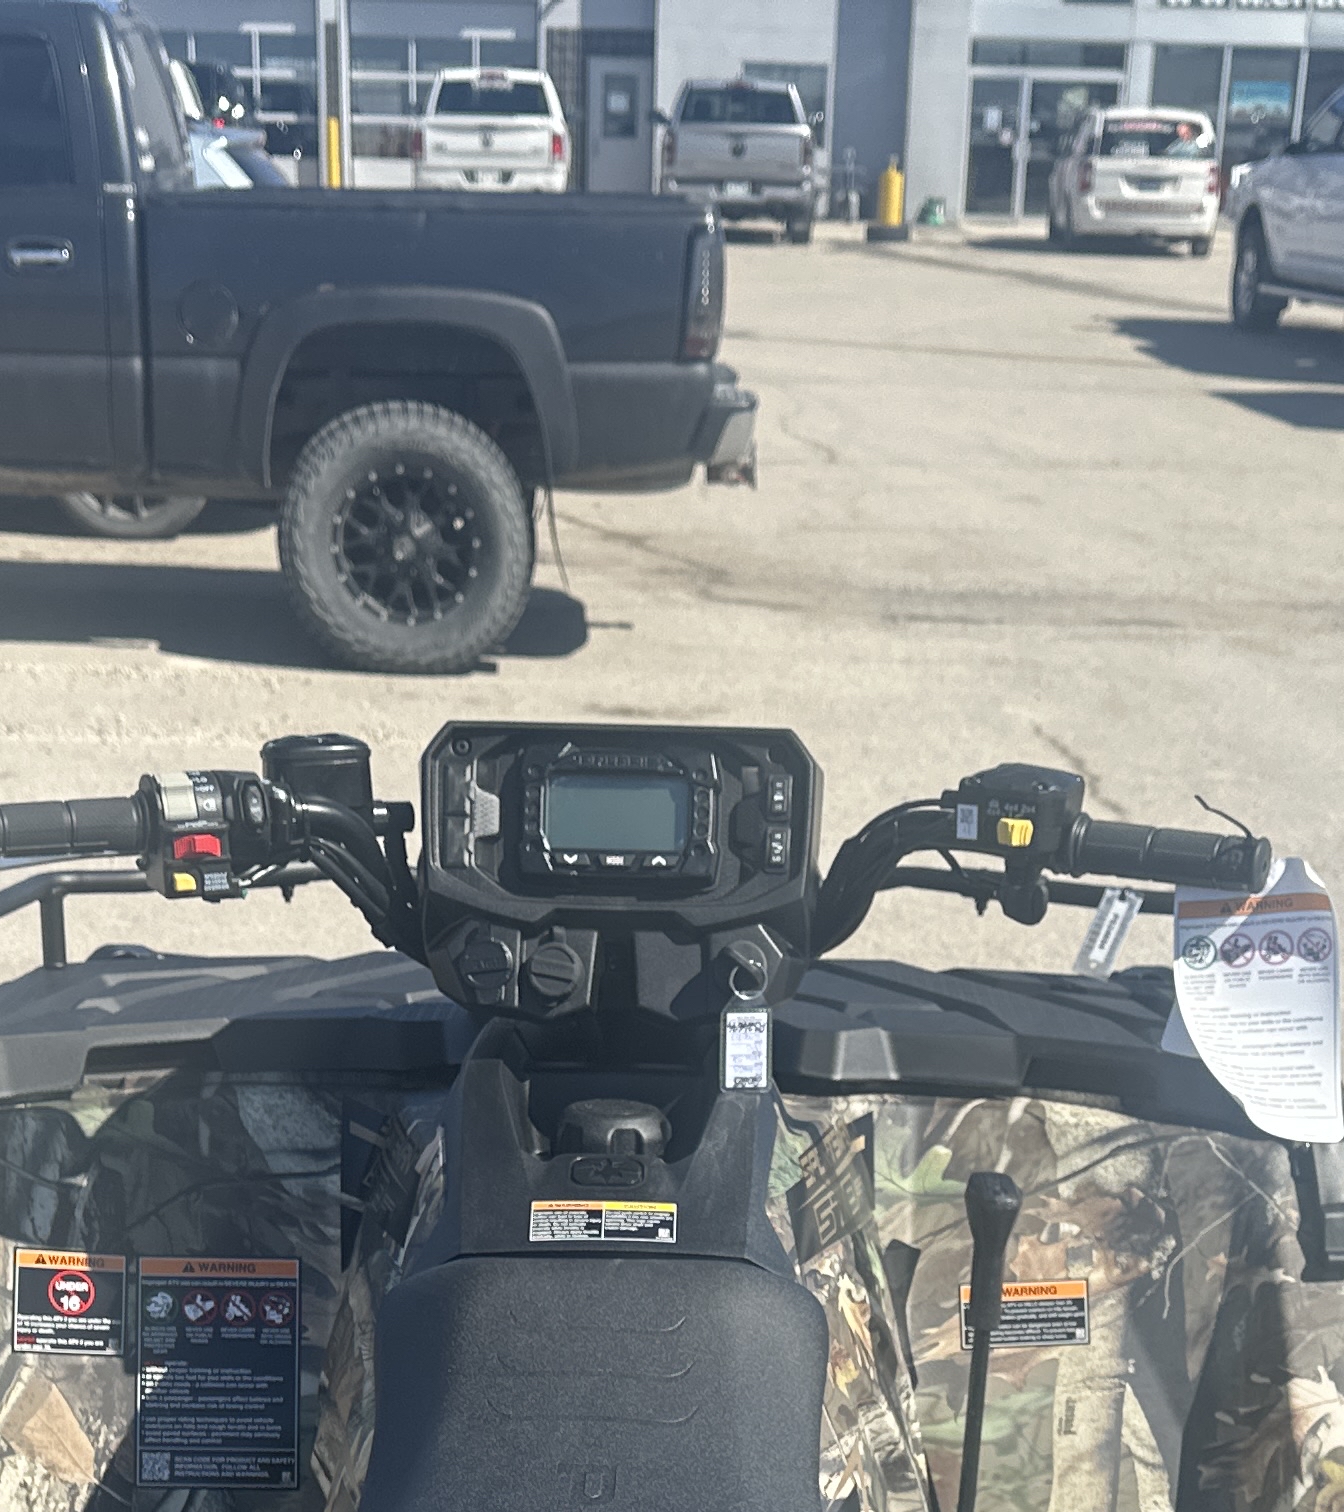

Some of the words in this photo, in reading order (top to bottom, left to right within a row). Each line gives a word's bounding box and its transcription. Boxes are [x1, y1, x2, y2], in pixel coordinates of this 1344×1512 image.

[48, 1256, 105, 1268] WARNING
[198, 1262, 256, 1273] WARNING
[55, 1281, 89, 1292] UNDER
[1002, 1286, 1058, 1298] WARNING
[60, 1295, 81, 1311] 16
